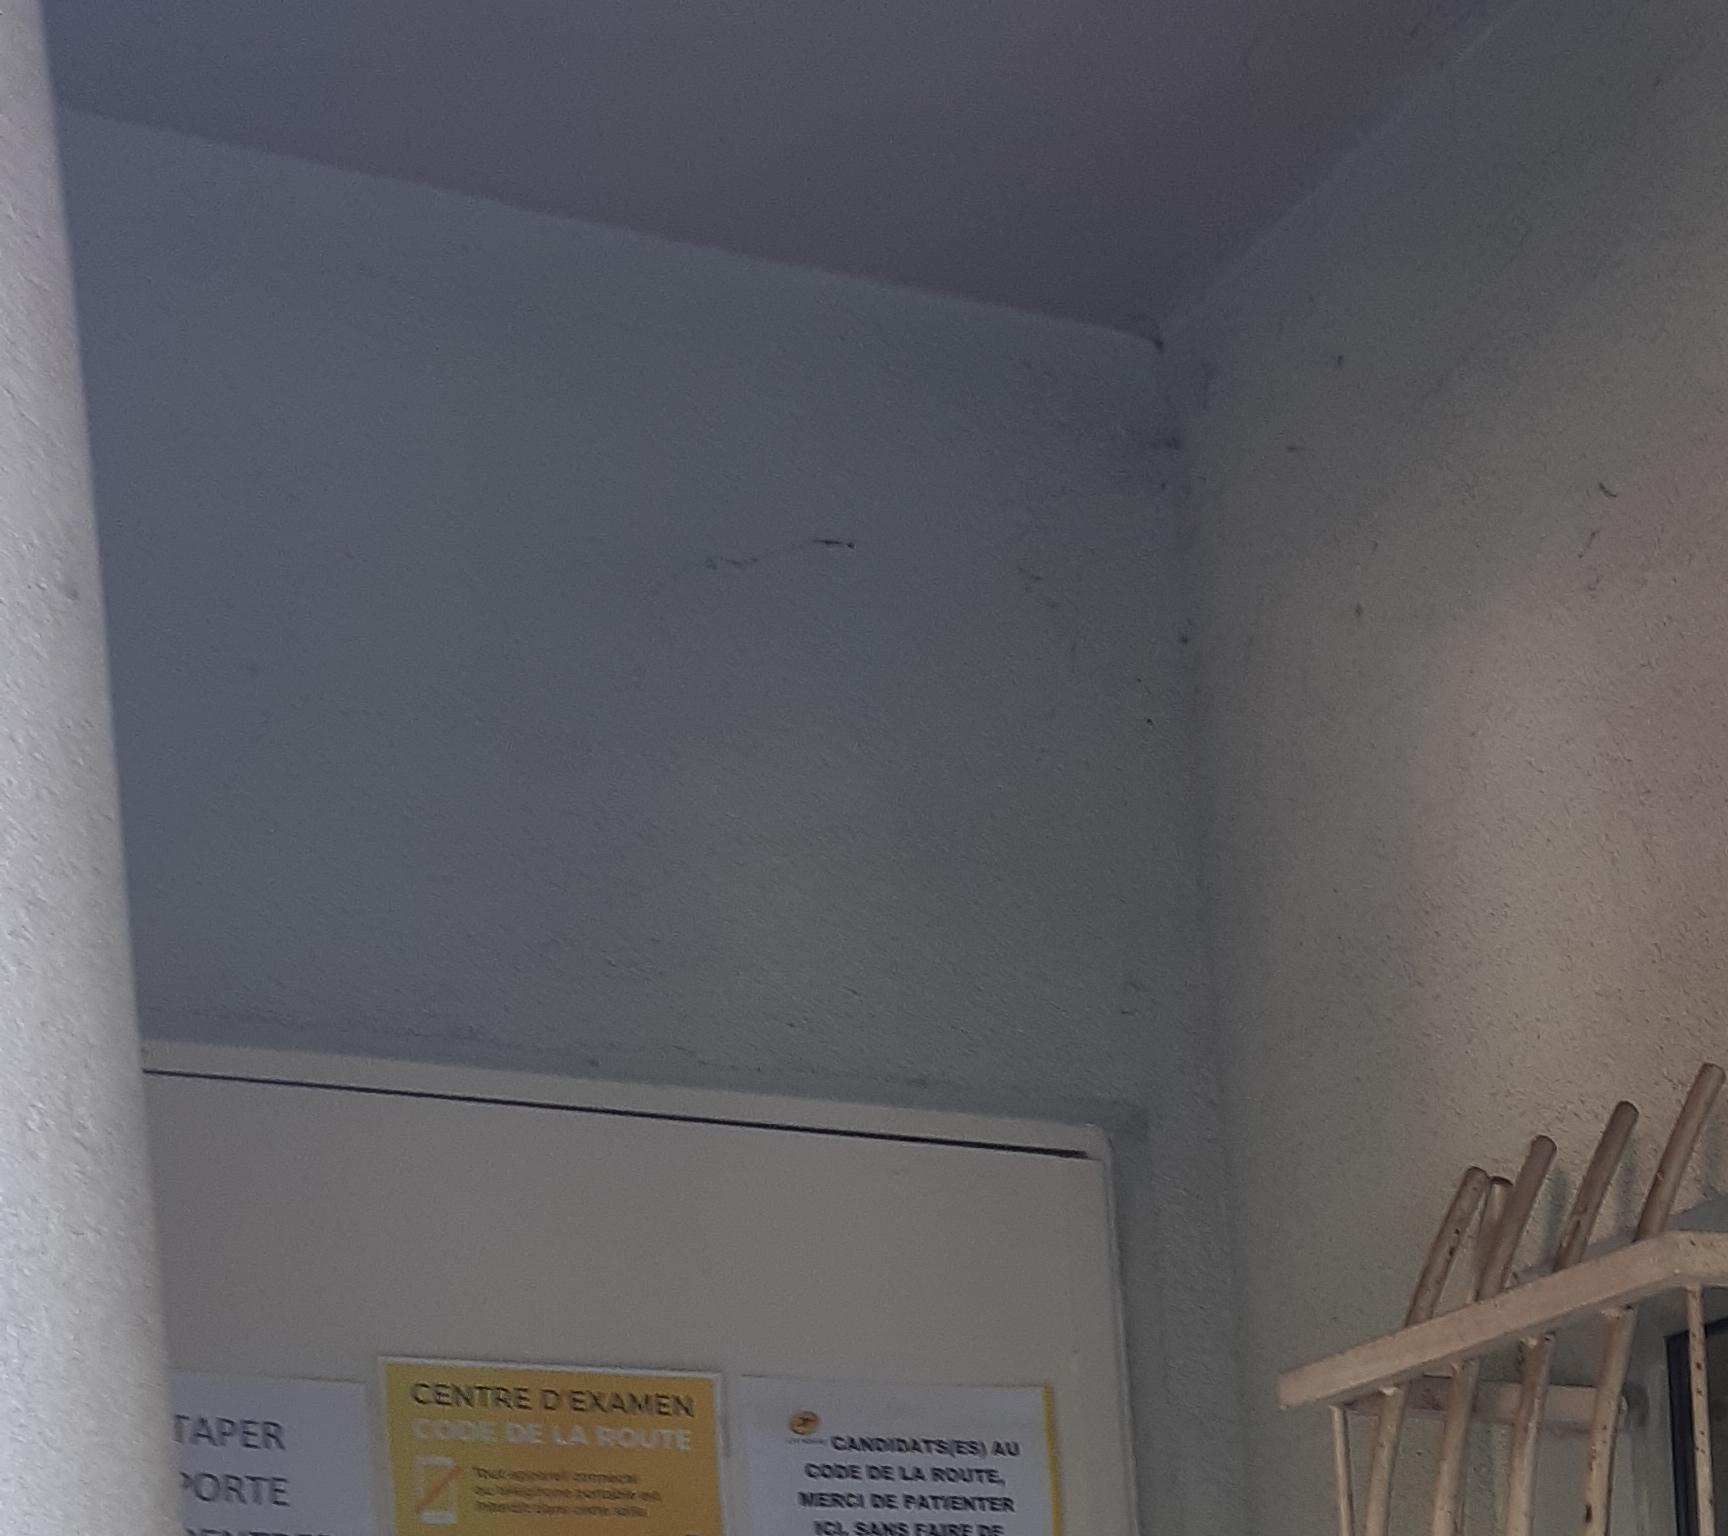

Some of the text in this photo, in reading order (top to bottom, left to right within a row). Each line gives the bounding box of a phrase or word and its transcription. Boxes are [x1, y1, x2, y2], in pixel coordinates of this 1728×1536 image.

[411, 1382, 532, 1411] CENTRE
[411, 1418, 692, 1451] CODE DE LA ROUTE
[831, 1435, 1021, 1459] CANDIDATS(ES) AU
[805, 1463, 863, 1481] CODE
[865, 1464, 896, 1481] DE
[901, 1465, 926, 1482] LA
[798, 1491, 1016, 1514] MERCI DE PATIENTER
